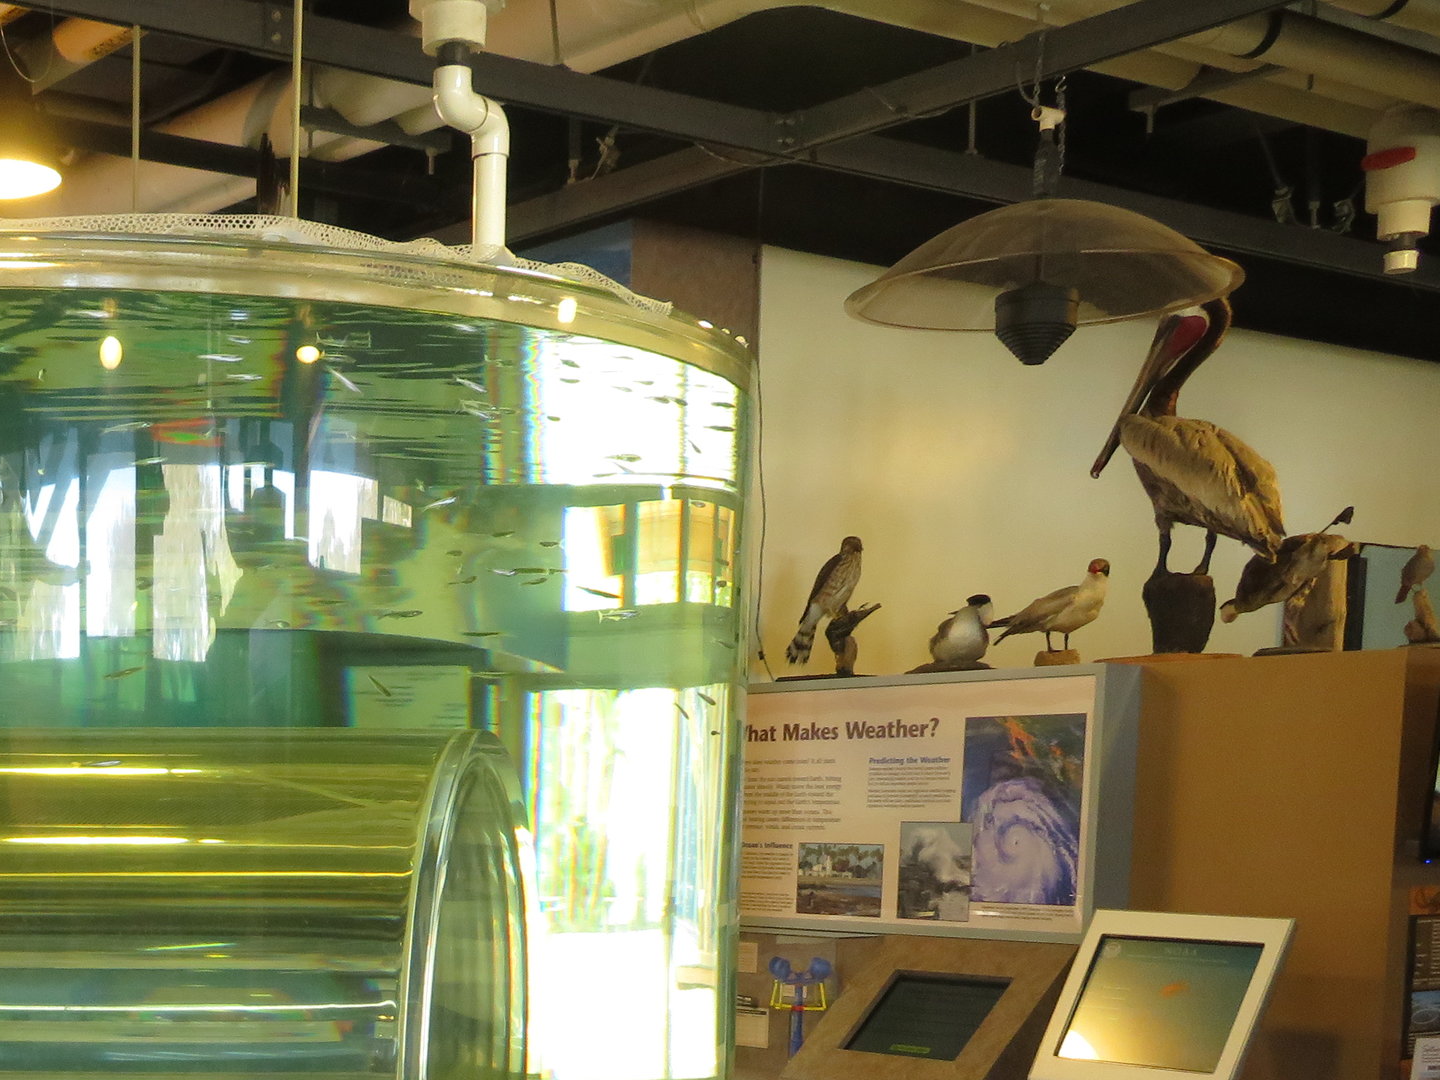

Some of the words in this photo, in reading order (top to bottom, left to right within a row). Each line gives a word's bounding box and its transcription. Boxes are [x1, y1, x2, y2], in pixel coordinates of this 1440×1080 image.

[744, 724, 776, 742] hat
[783, 721, 839, 741] Makes
[845, 717, 940, 740] Weather?
[869, 756, 904, 766] Predicting
[906, 756, 918, 764] the
[920, 756, 951, 764] Weather
